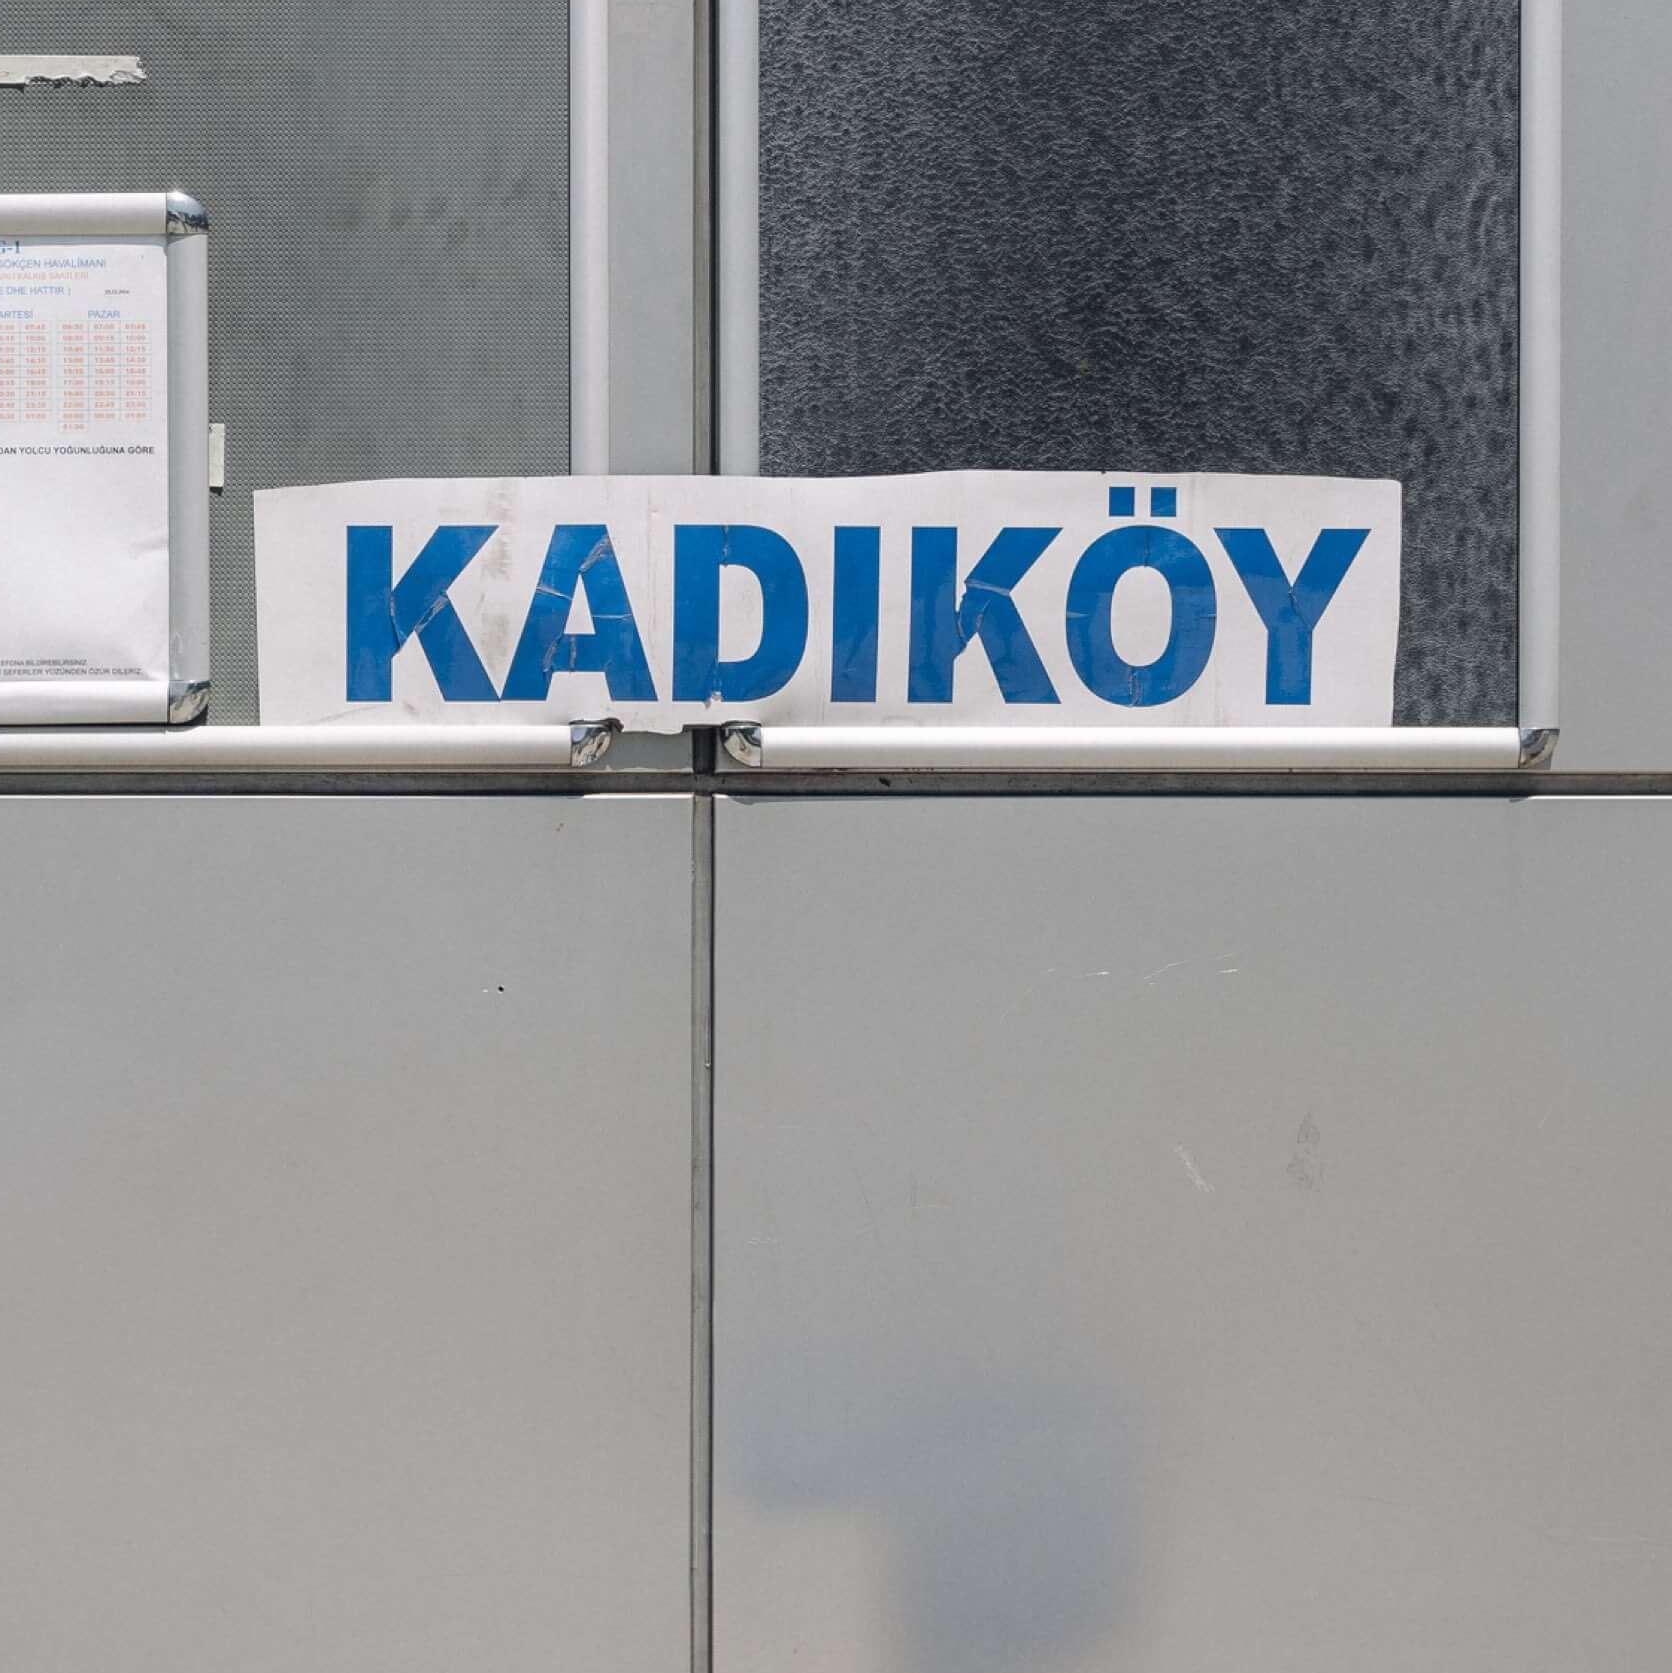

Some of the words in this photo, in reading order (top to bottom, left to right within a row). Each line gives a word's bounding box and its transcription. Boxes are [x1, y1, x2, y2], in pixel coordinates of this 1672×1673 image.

[19, 446, 51, 455] YOLCU
[127, 445, 155, 455] GÖRE
[344, 485, 1374, 708] KADIKÖY
